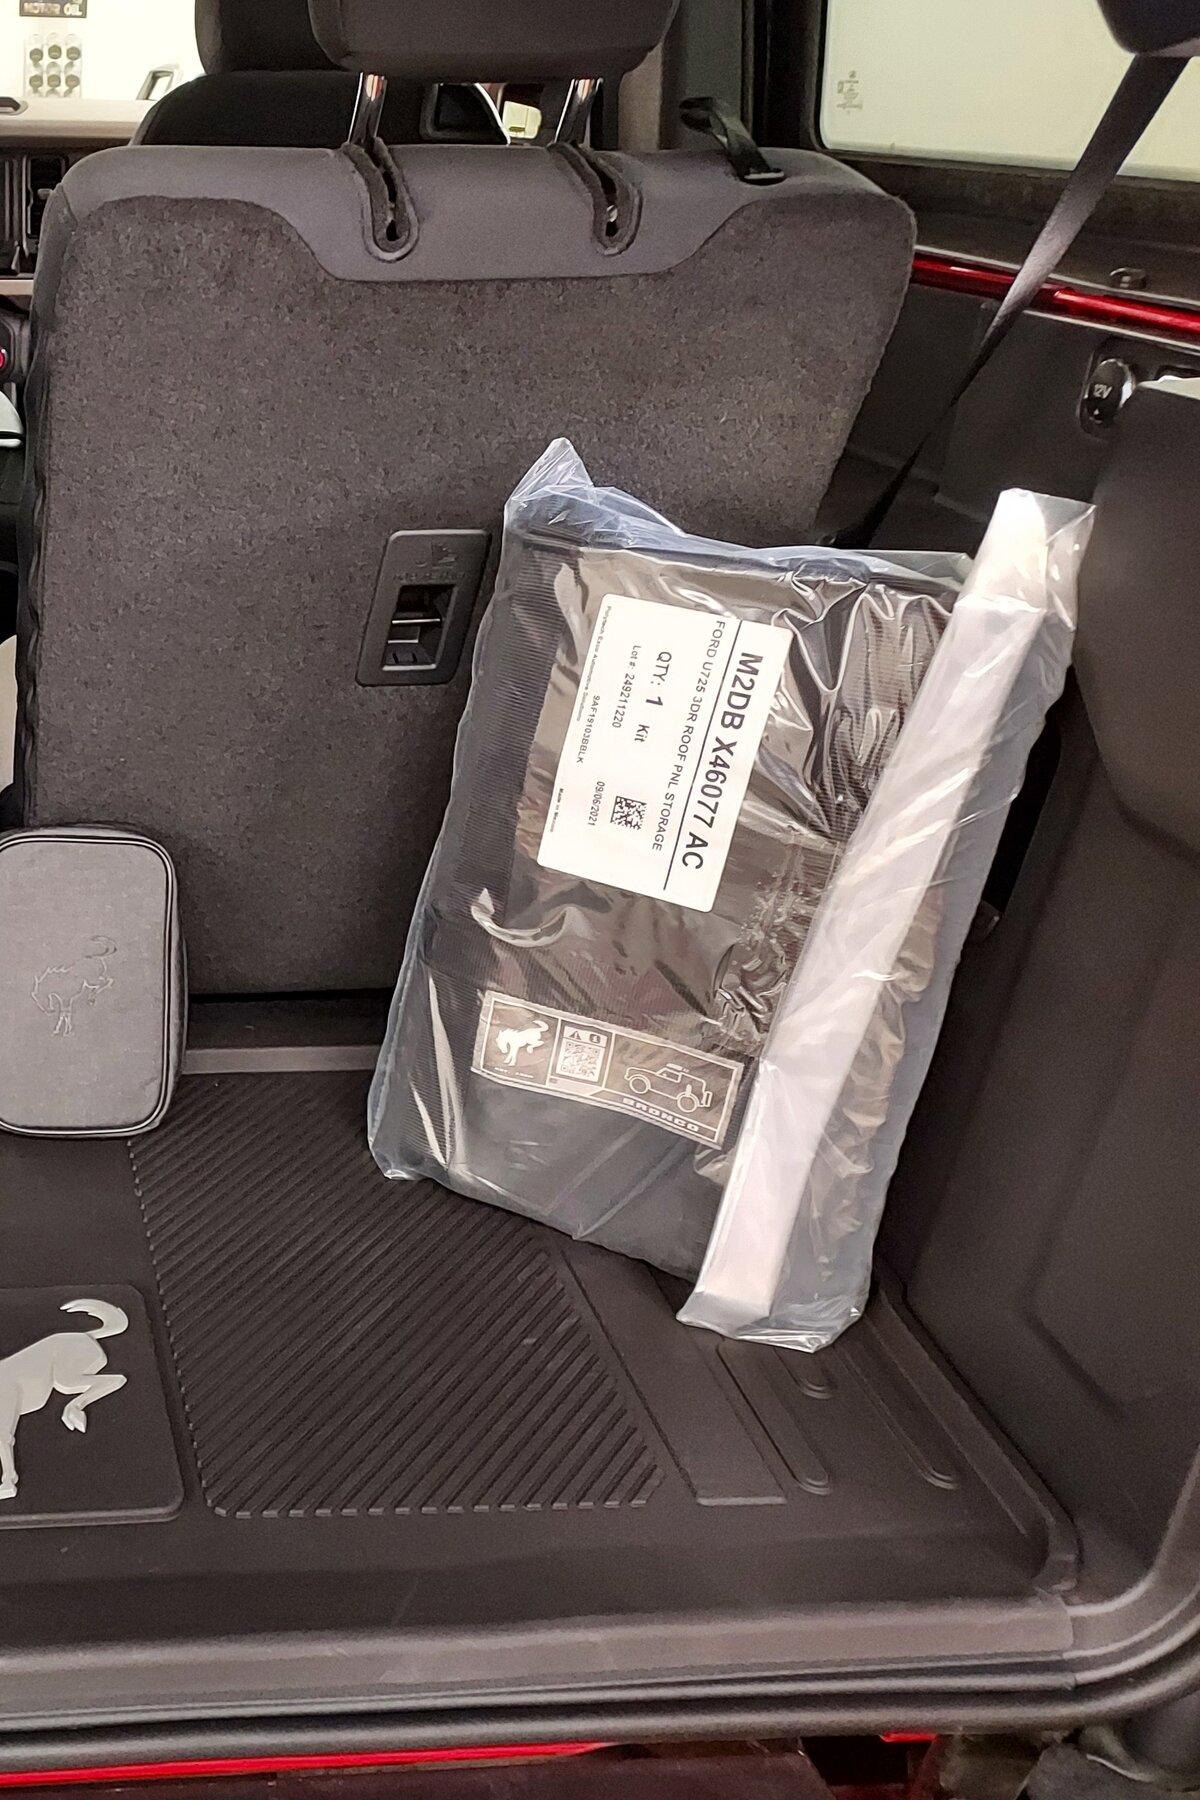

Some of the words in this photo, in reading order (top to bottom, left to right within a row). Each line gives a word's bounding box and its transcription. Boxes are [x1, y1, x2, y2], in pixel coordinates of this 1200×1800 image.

[1093, 384, 1113, 399] 12V
[629, 644, 642, 660] Lot
[706, 620, 726, 658] FORD
[650, 651, 673, 686] QTY:
[695, 661, 714, 693] U725
[611, 672, 635, 729] 249211220
[645, 696, 664, 707] 1
[686, 695, 703, 722] 3DR
[720, 652, 764, 730] M2DB
[634, 723, 650, 743] Kit
[676, 725, 695, 762] ROOF
[667, 764, 684, 789] PNL
[693, 736, 738, 829] X46077
[587, 780, 606, 826] 09/06/2021
[651, 792, 675, 852] STORAGE
[681, 831, 709, 870] AC
[622, 1097, 699, 1132] BRONCO
